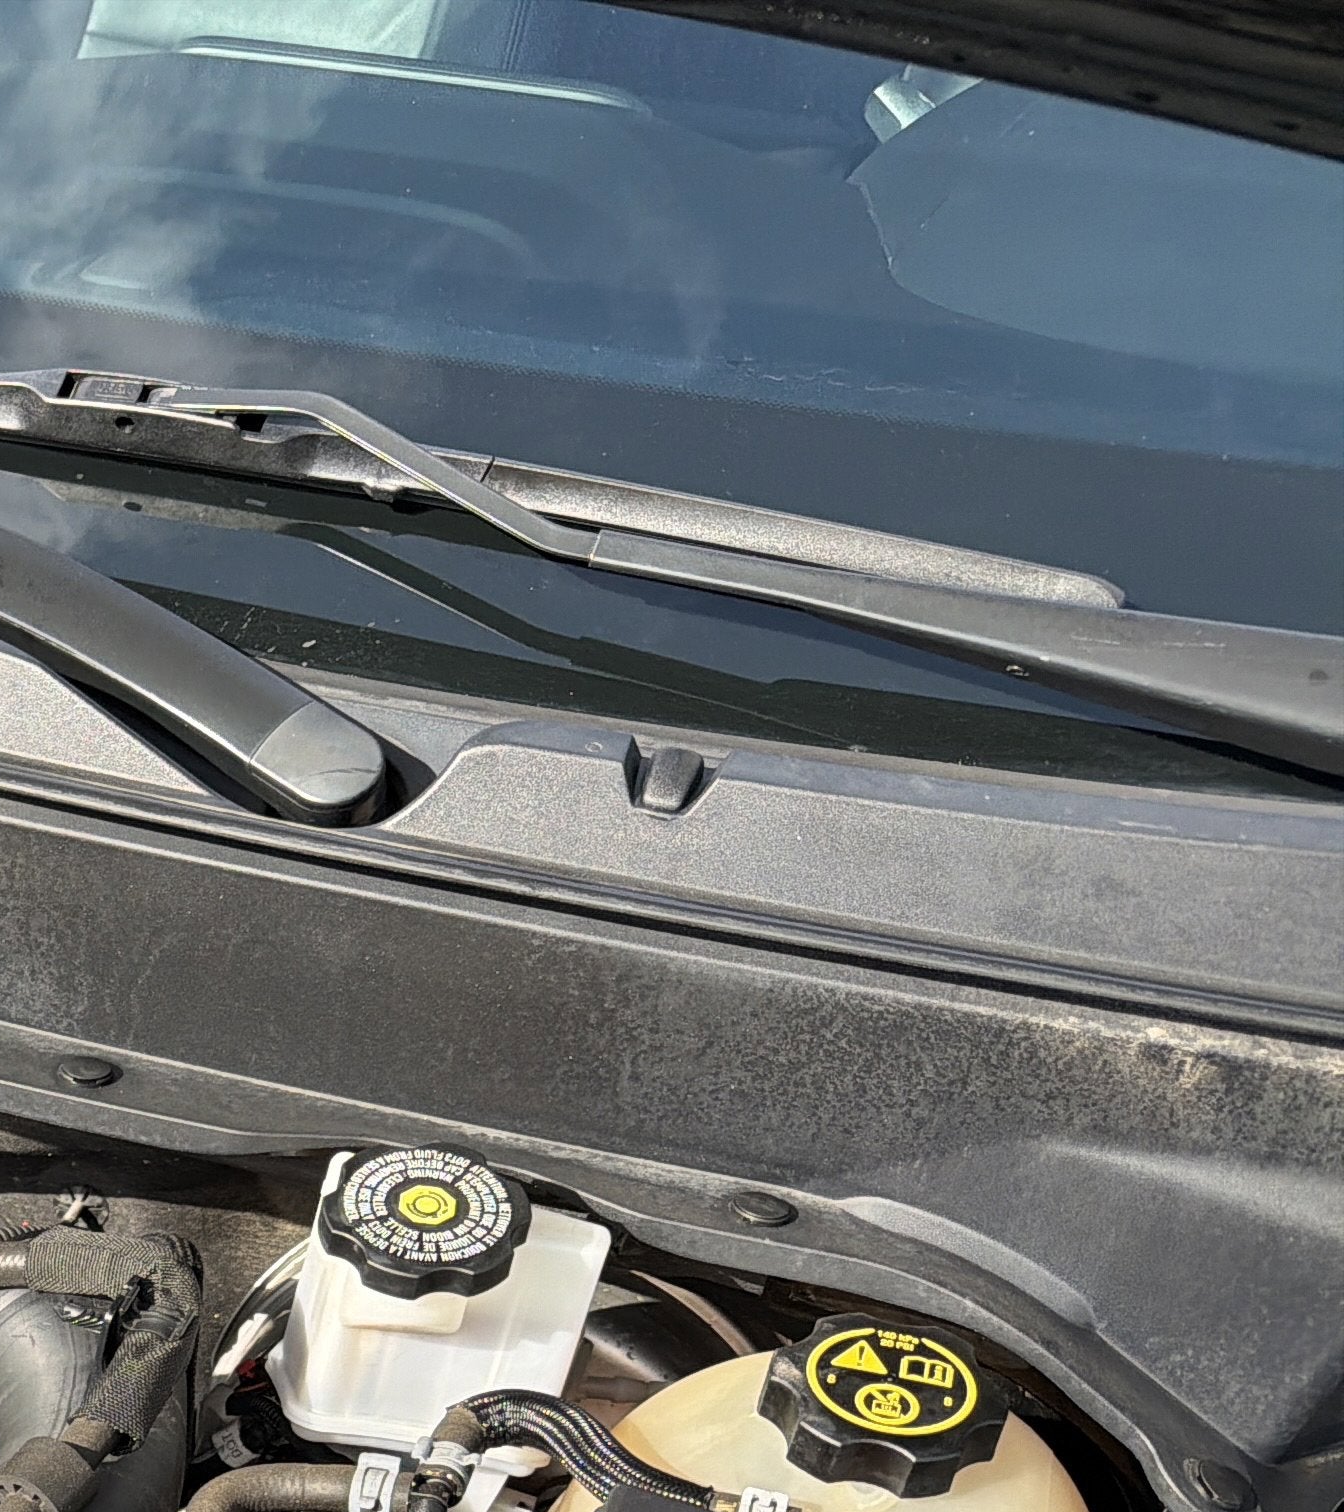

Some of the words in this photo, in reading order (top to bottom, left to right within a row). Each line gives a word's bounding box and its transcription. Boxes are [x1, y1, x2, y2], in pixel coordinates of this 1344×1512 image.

[383, 1150, 413, 1164] FROM
[413, 1149, 444, 1160] FLUID
[404, 1157, 444, 1170] BEFORE
[443, 1164, 465, 1176] CAP
[350, 1160, 380, 1184] SEALED
[376, 1173, 404, 1193] CLEAN
[372, 1191, 387, 1217] FILLER
[389, 1234, 420, 1250] FREIN
[422, 1230, 455, 1243] BIDON
[482, 1234, 498, 1246] LE
[389, 1244, 404, 1256] LA
[423, 1241, 436, 1252] DE
[440, 1240, 486, 1262] BOUCHON
[404, 1250, 438, 1262] AVANT
